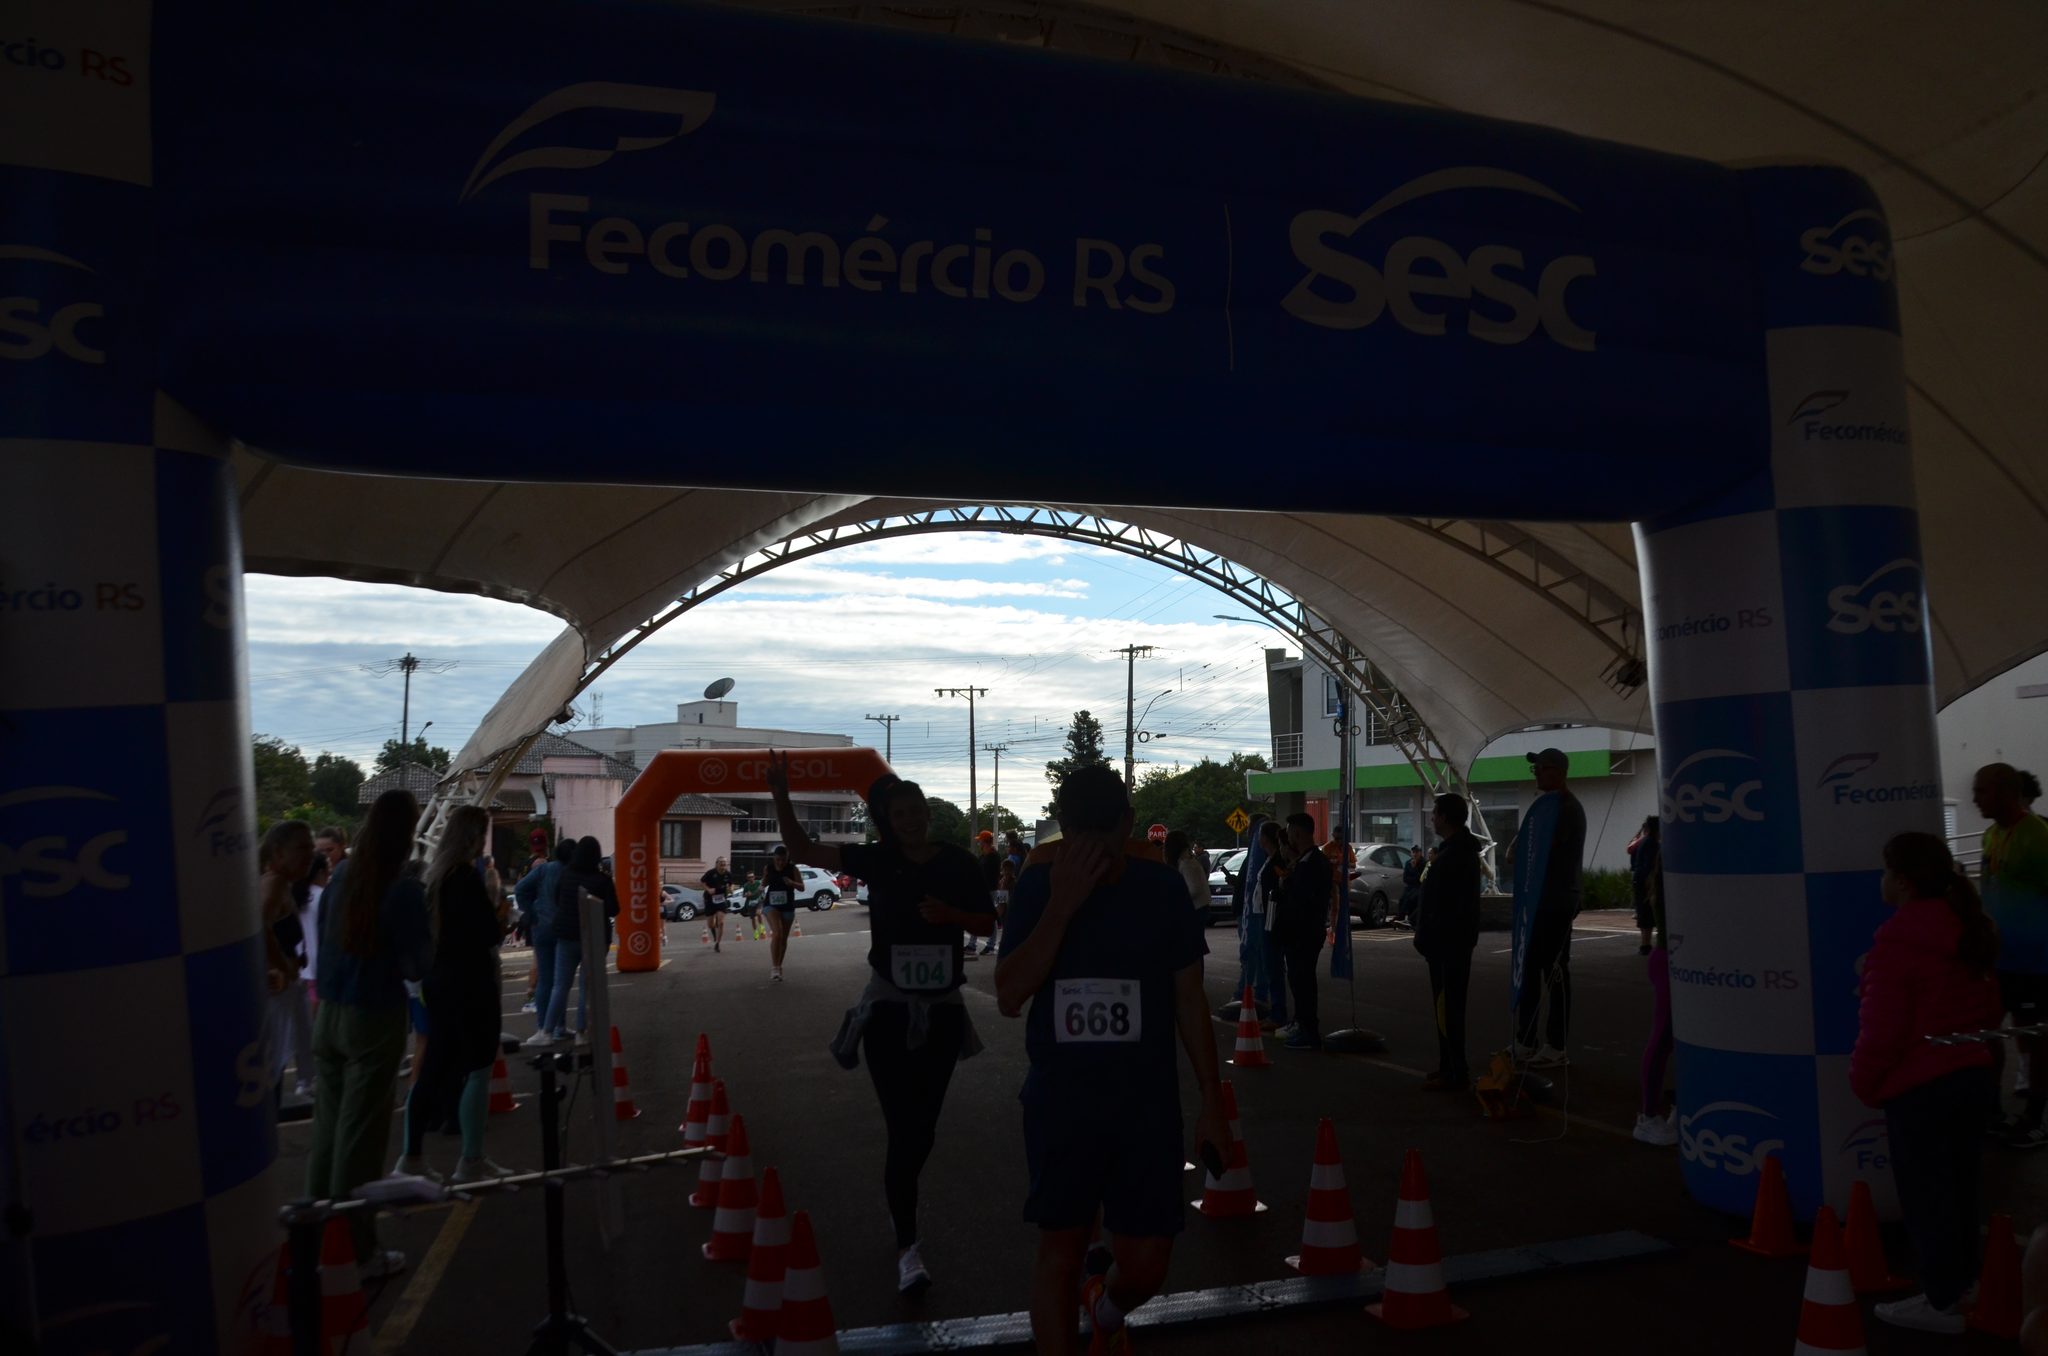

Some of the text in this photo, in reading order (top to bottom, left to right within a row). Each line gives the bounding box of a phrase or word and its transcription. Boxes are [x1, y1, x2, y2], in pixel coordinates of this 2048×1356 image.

[81, 48, 133, 86] RS
[529, 193, 1177, 314] Fecomércio RS
[1280, 206, 1598, 353] Sesc
[95, 582, 145, 611] RS
[1738, 606, 1774, 630] RS
[1150, 830, 1168, 840] PARE
[630, 834, 648, 924] CRESOL
[900, 960, 945, 985] 104
[1763, 968, 1799, 990] RS
[1065, 1001, 1130, 1036] 668
[135, 1091, 181, 1127] RS
